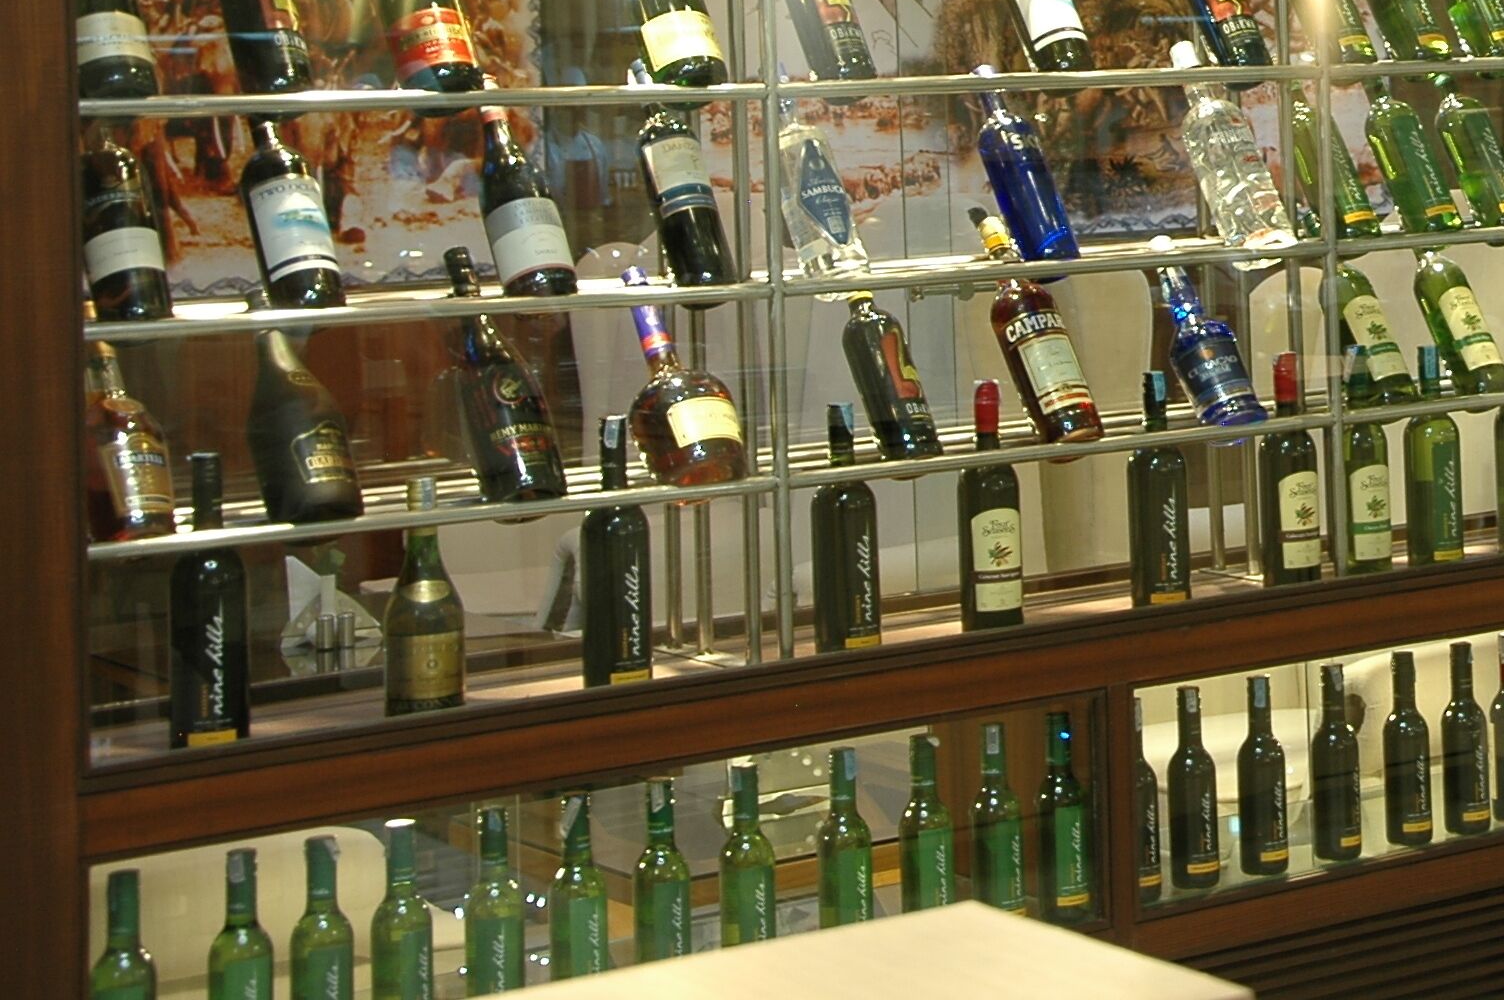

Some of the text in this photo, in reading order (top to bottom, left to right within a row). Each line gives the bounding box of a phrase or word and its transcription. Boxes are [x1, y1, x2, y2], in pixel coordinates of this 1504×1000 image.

[1005, 313, 1064, 343] CAMPAR
[1162, 483, 1178, 580] nine hills
[856, 520, 874, 621] nine hills
[624, 551, 640, 656] nine hills
[204, 596, 224, 716] nine hills
[858, 897, 867, 922] ine
[676, 928, 684, 957] ine
[757, 914, 768, 942] ine
[592, 949, 602, 976] ine
[497, 969, 506, 993] ine
